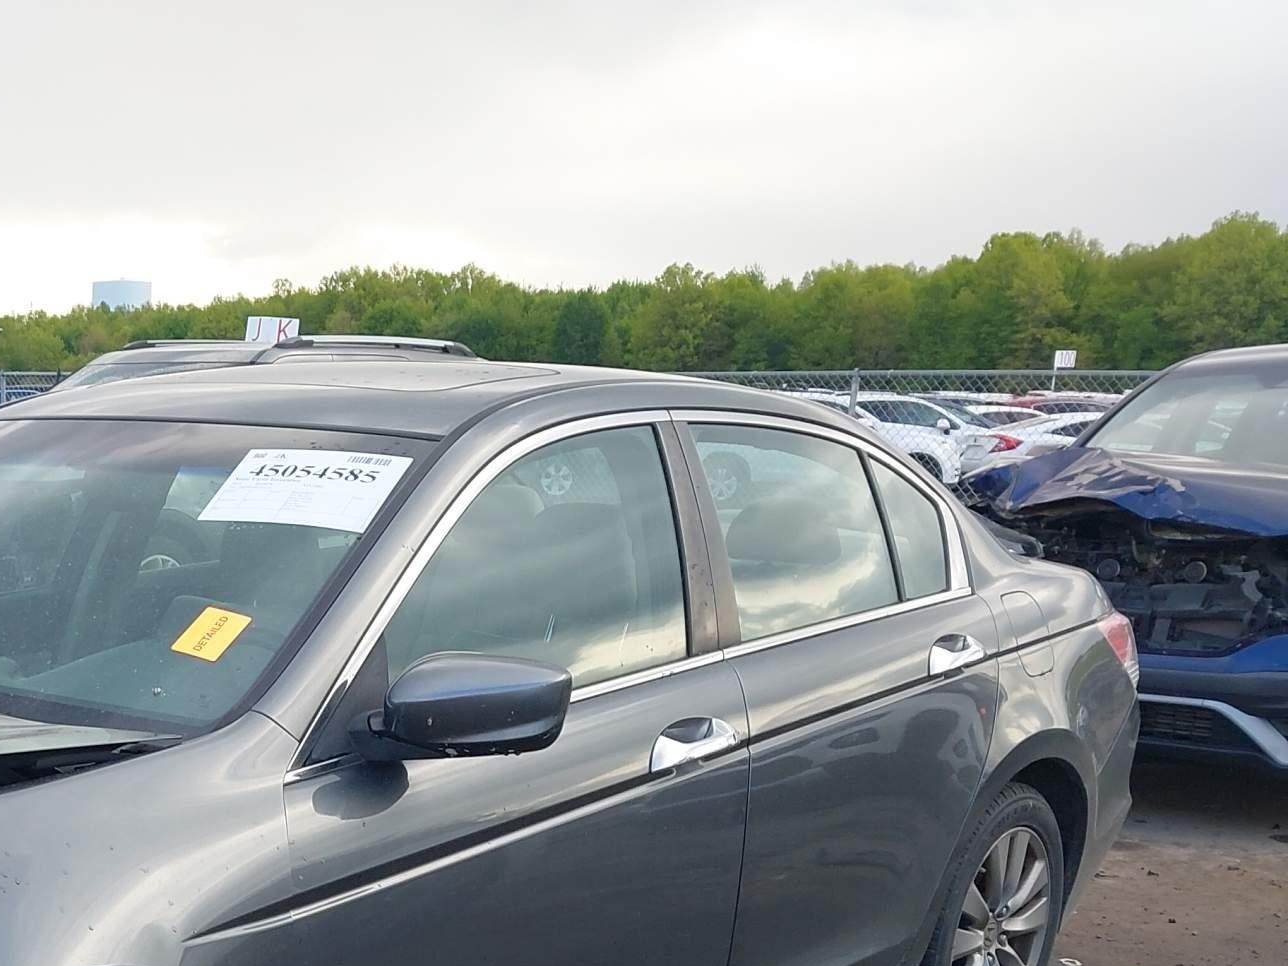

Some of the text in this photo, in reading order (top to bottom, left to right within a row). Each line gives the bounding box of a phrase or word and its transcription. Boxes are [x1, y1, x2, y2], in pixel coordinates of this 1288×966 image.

[277, 319, 293, 344] K
[249, 463, 381, 483] 45054585
[193, 616, 229, 652] DETAILED
